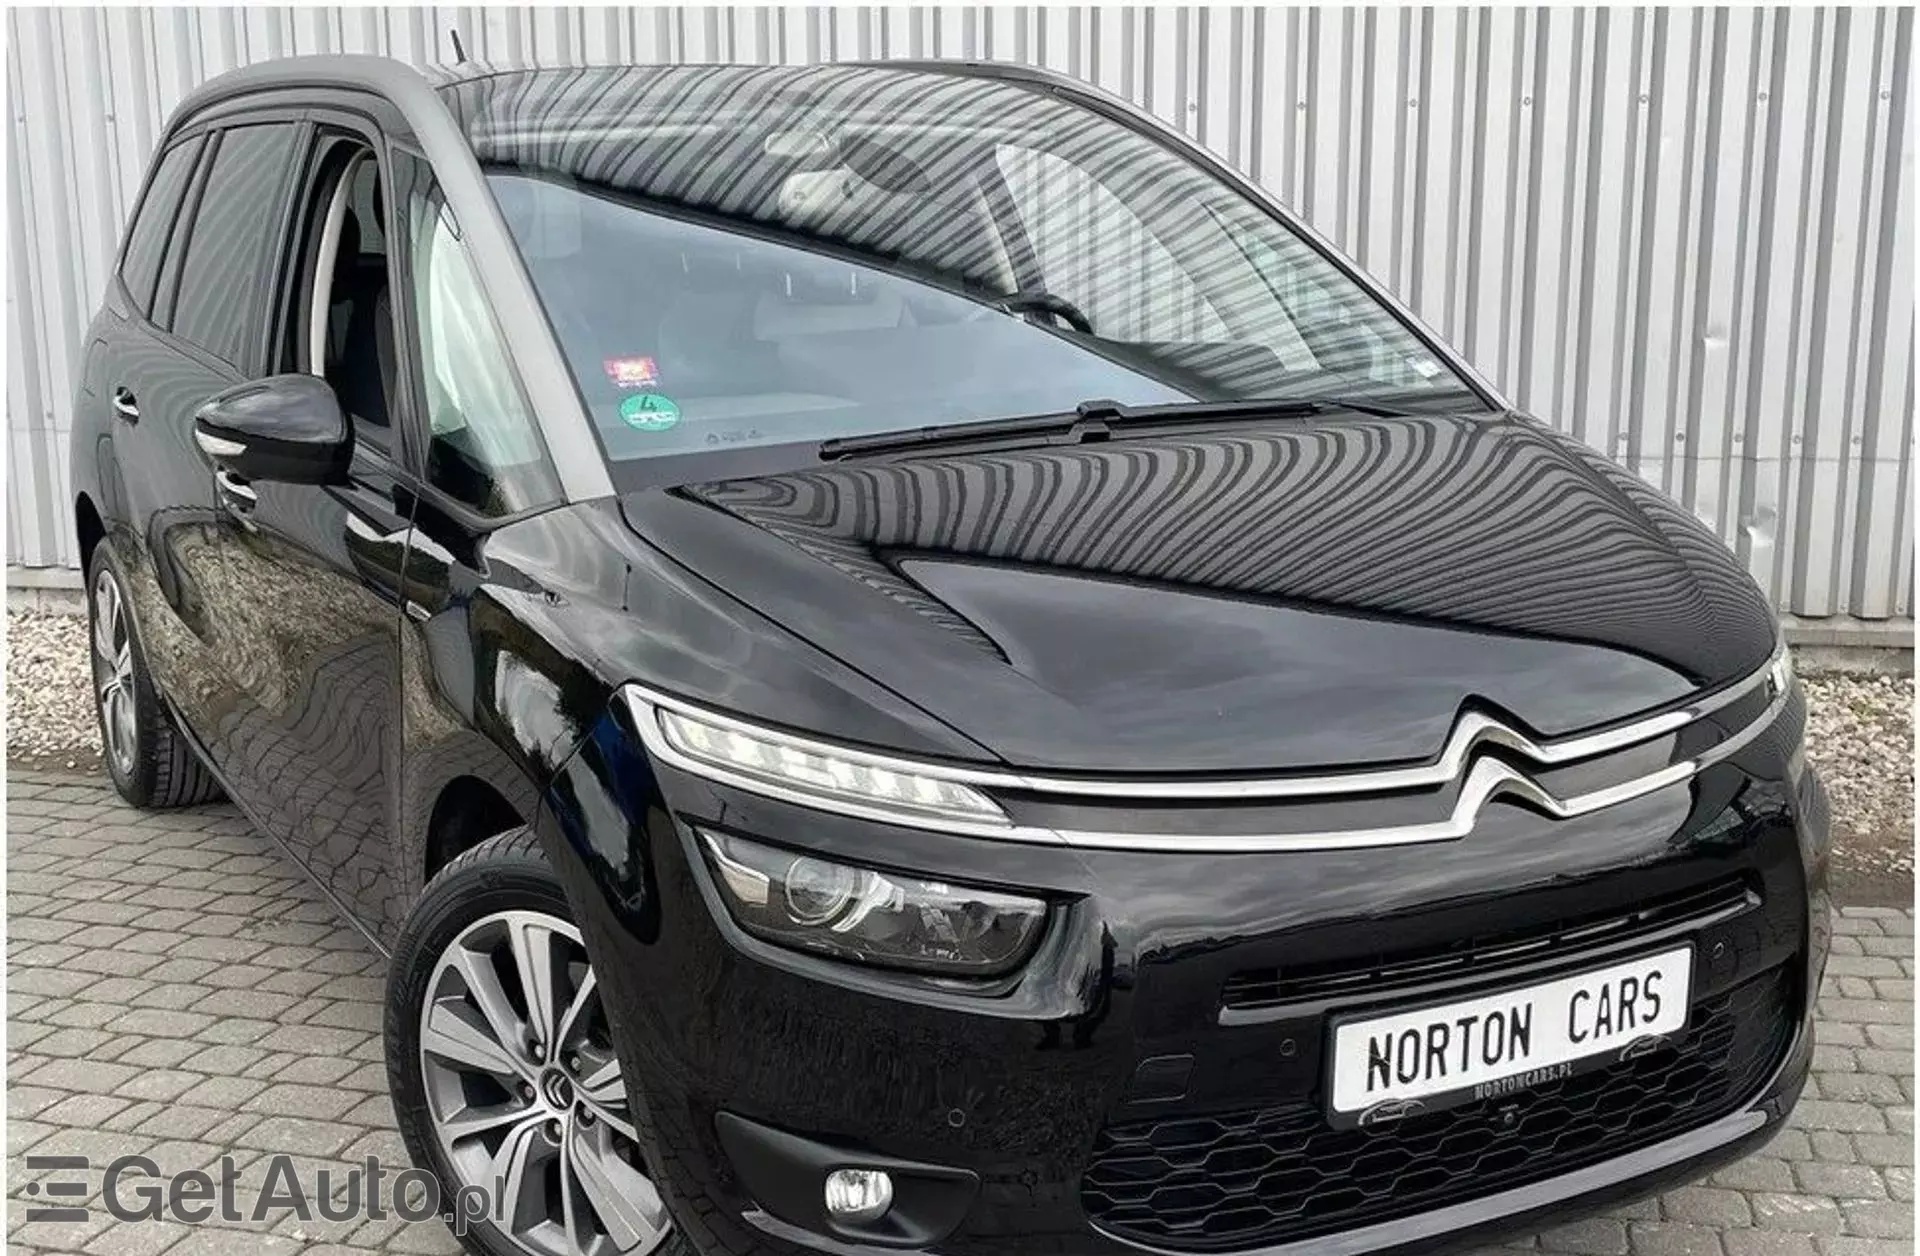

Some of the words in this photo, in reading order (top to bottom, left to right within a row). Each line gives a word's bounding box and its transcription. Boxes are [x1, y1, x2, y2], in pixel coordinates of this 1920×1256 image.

[641, 395, 657, 412] 4
[1367, 1003, 1532, 1091] NORTON
[1569, 971, 1662, 1043] CARS
[1474, 1063, 1574, 1100] NORTONCARS.PL
